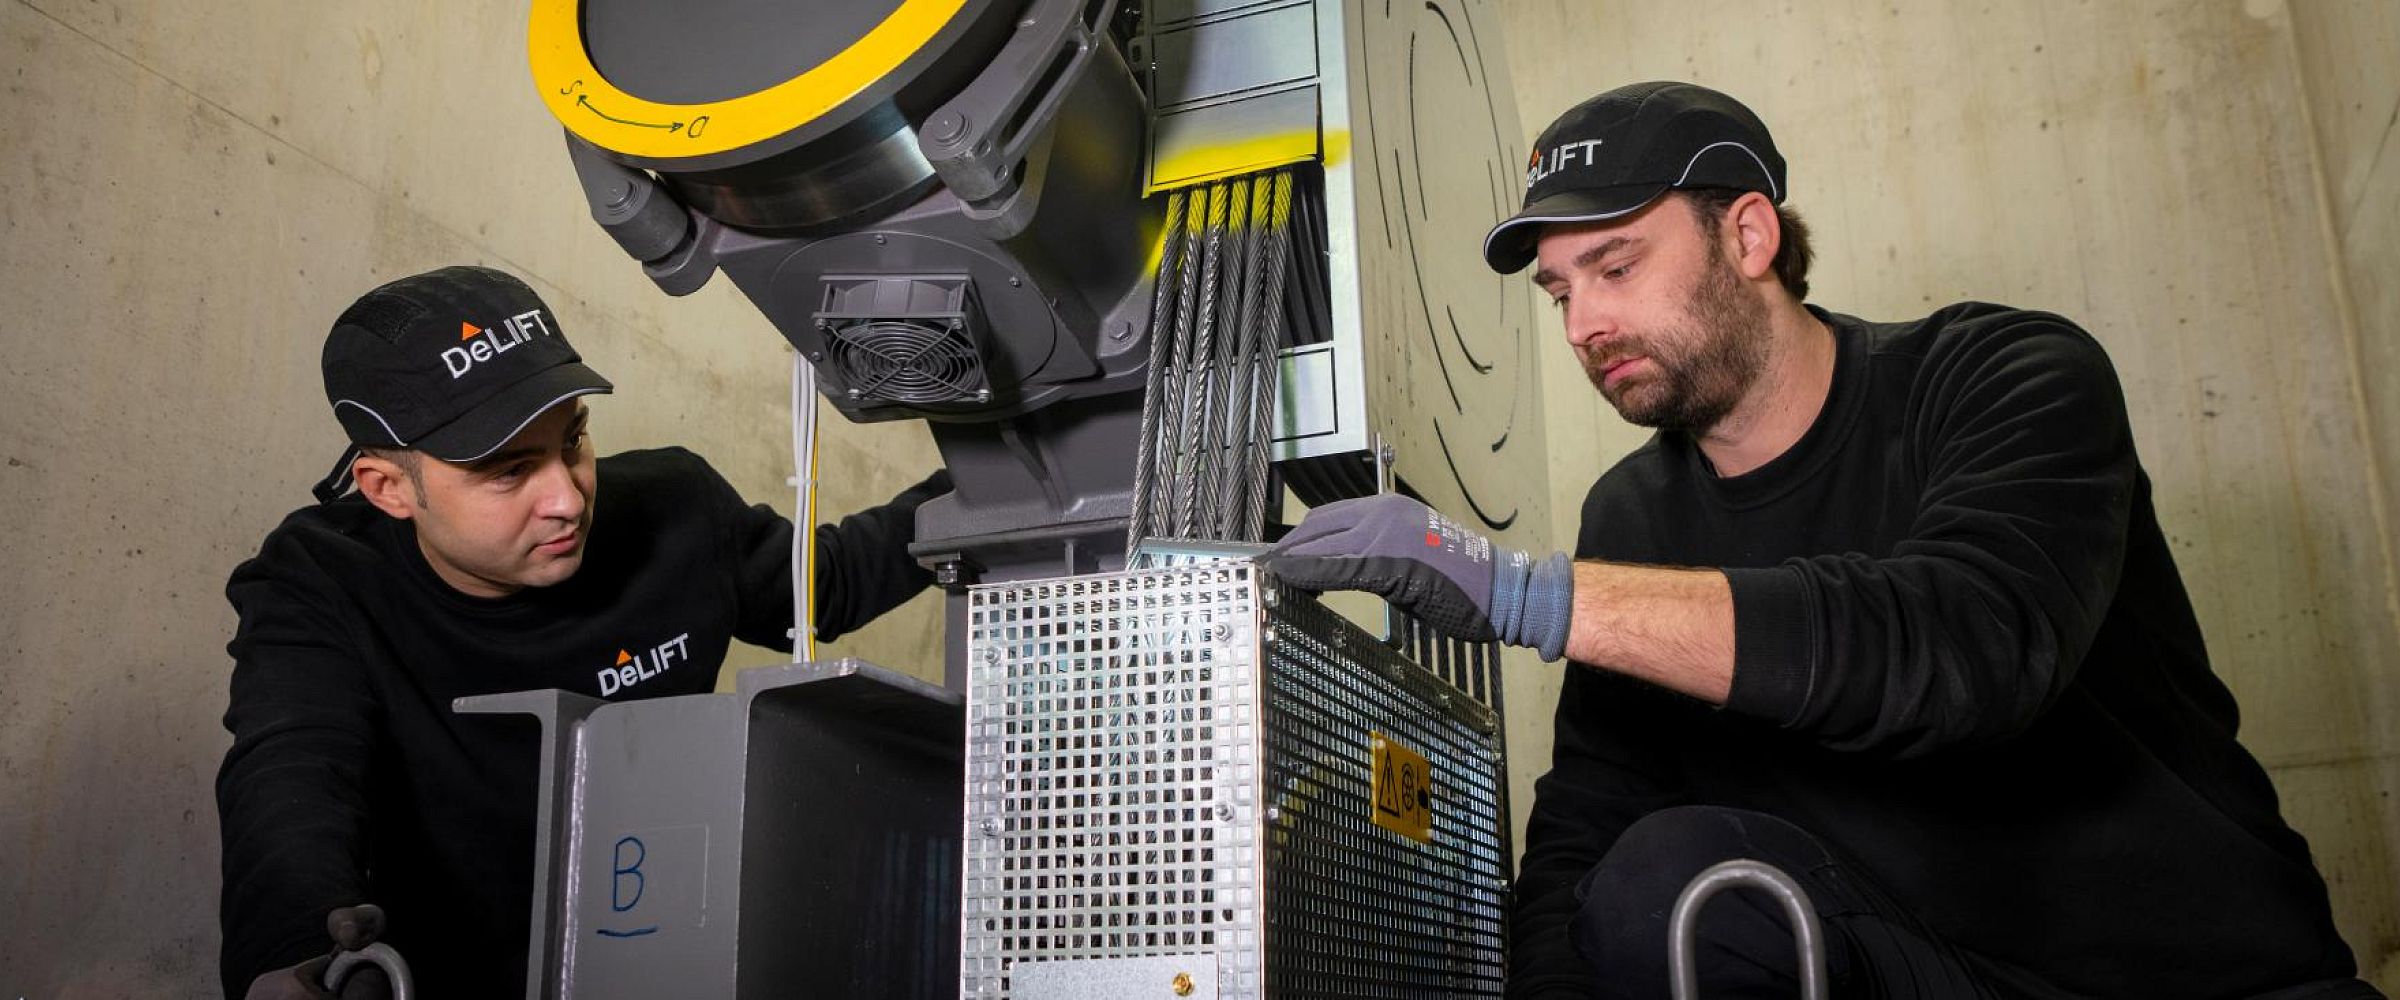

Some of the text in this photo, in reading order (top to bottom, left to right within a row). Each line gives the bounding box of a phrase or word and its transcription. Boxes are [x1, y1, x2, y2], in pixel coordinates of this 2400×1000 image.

[1526, 139, 1603, 188] eLIFT
[440, 309, 550, 379] DeLIFT
[597, 632, 689, 697] DeLIFT
[612, 836, 646, 912] B
